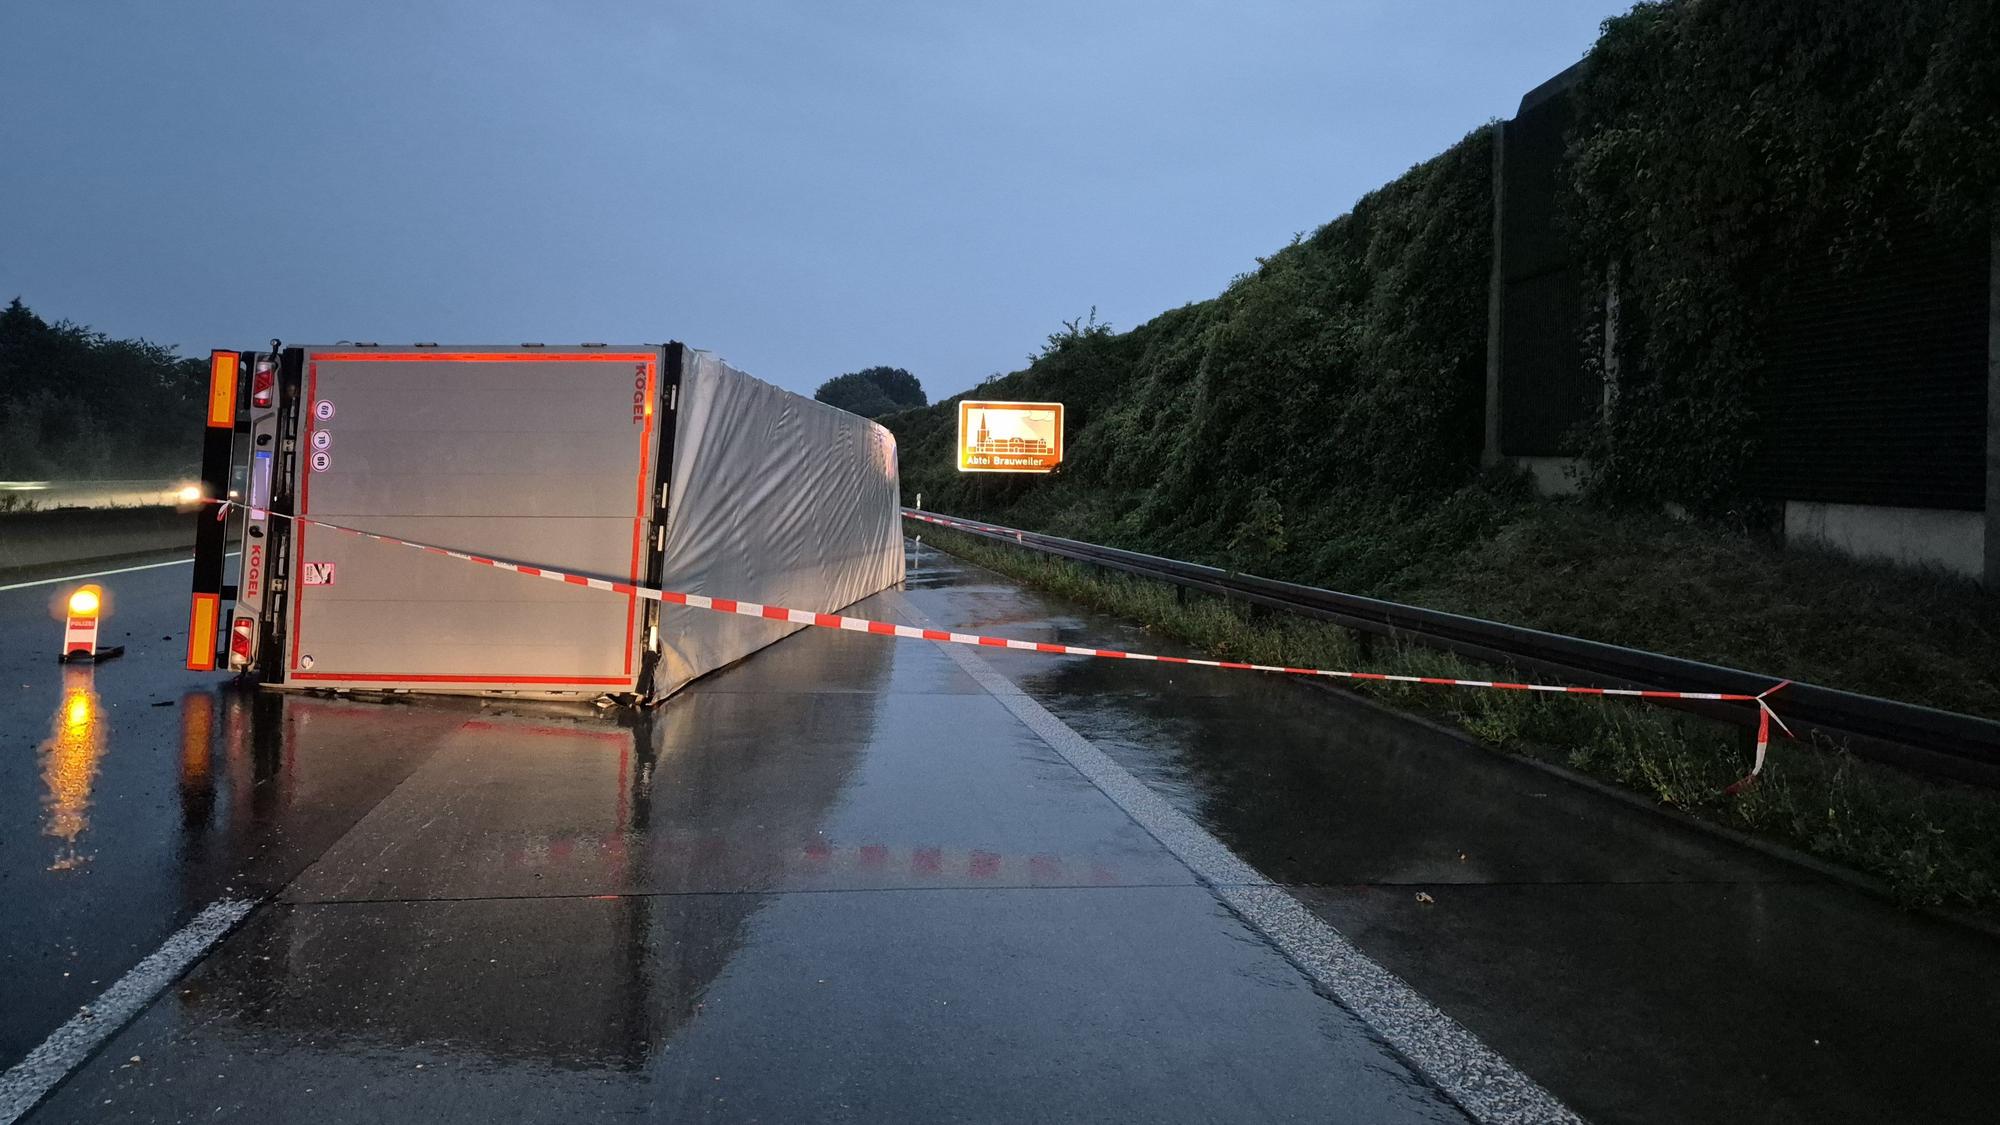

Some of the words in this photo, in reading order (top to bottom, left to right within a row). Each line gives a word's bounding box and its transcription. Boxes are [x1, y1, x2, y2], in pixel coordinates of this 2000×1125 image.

[321, 405, 329, 416] 60
[317, 456, 325, 467] 80
[967, 456, 991, 466] Abtei
[993, 456, 1044, 467] Brauweiler
